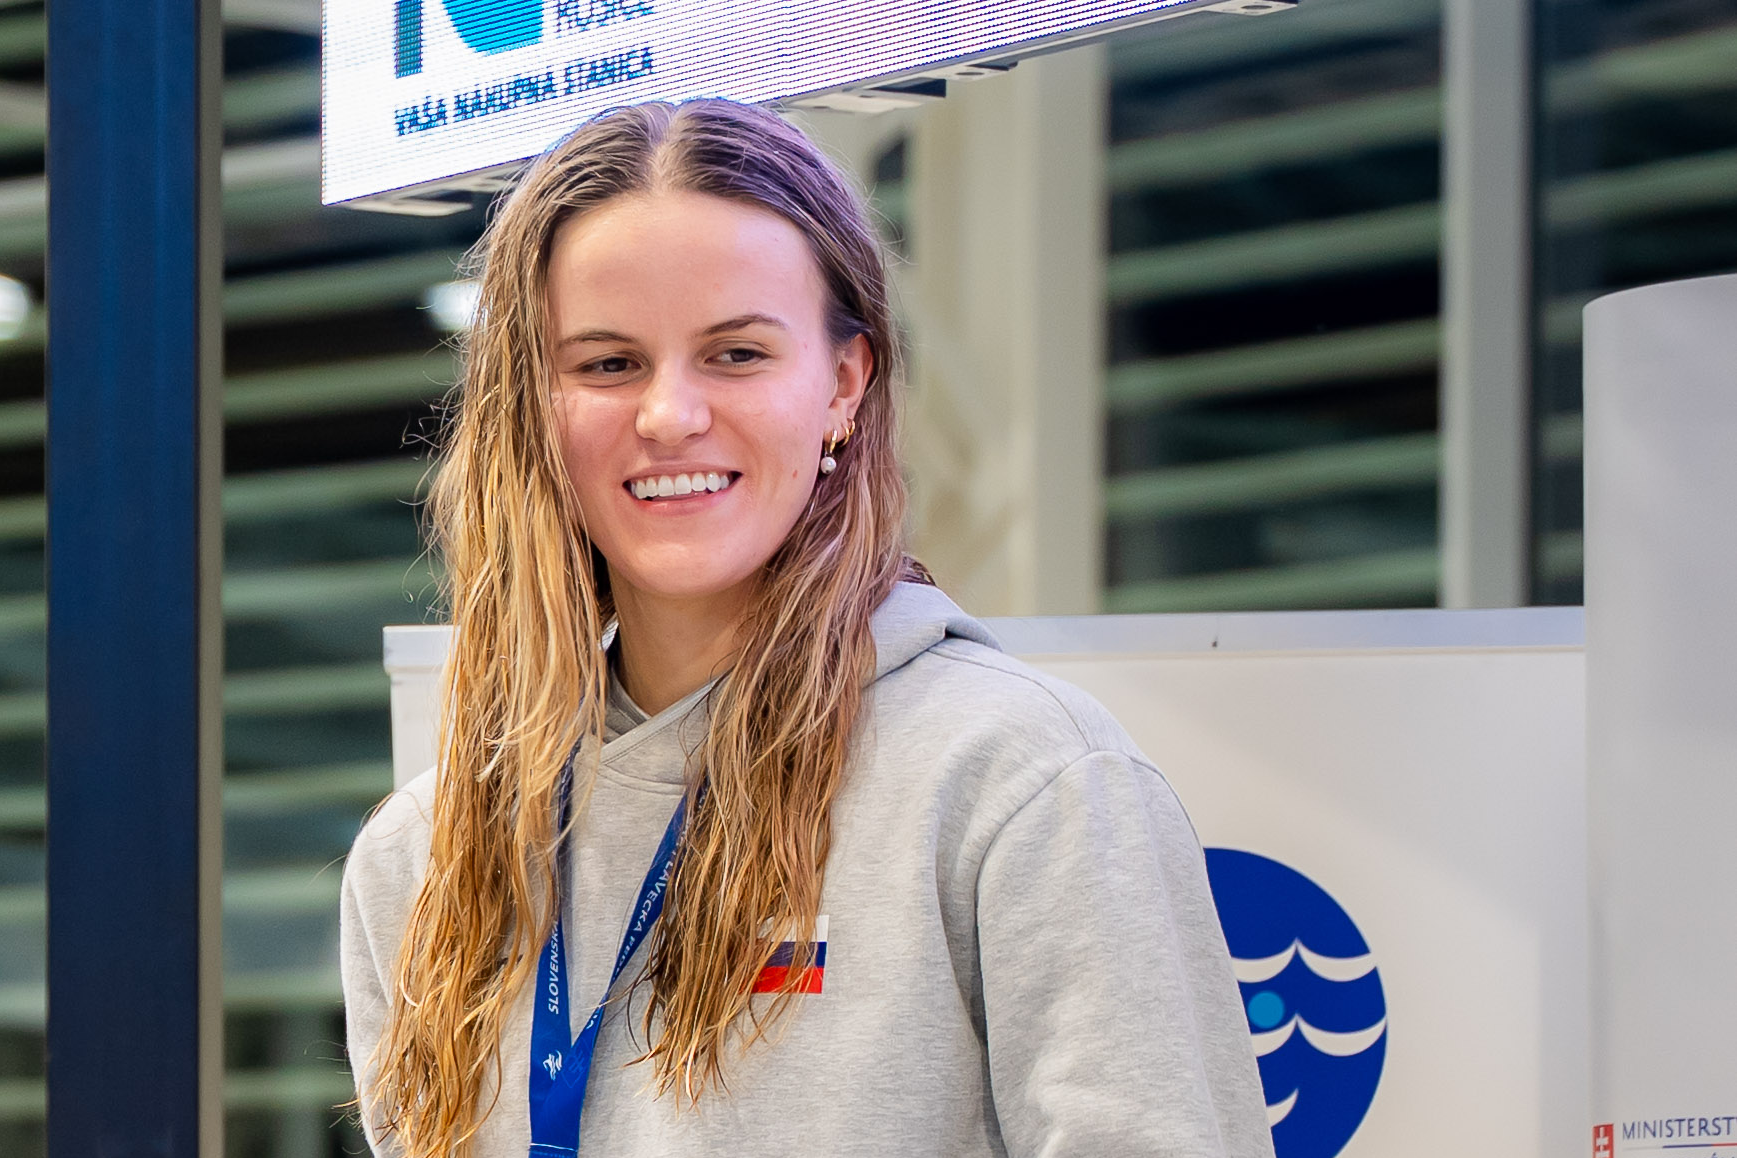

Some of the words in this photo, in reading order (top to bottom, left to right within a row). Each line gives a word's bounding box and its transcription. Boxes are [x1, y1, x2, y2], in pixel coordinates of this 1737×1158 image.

[394, 95, 447, 137] VAŠA
[564, 46, 654, 96] STANICA
[634, 850, 677, 931] LAVECKA
[1622, 1116, 1737, 1140] MINISTERST
